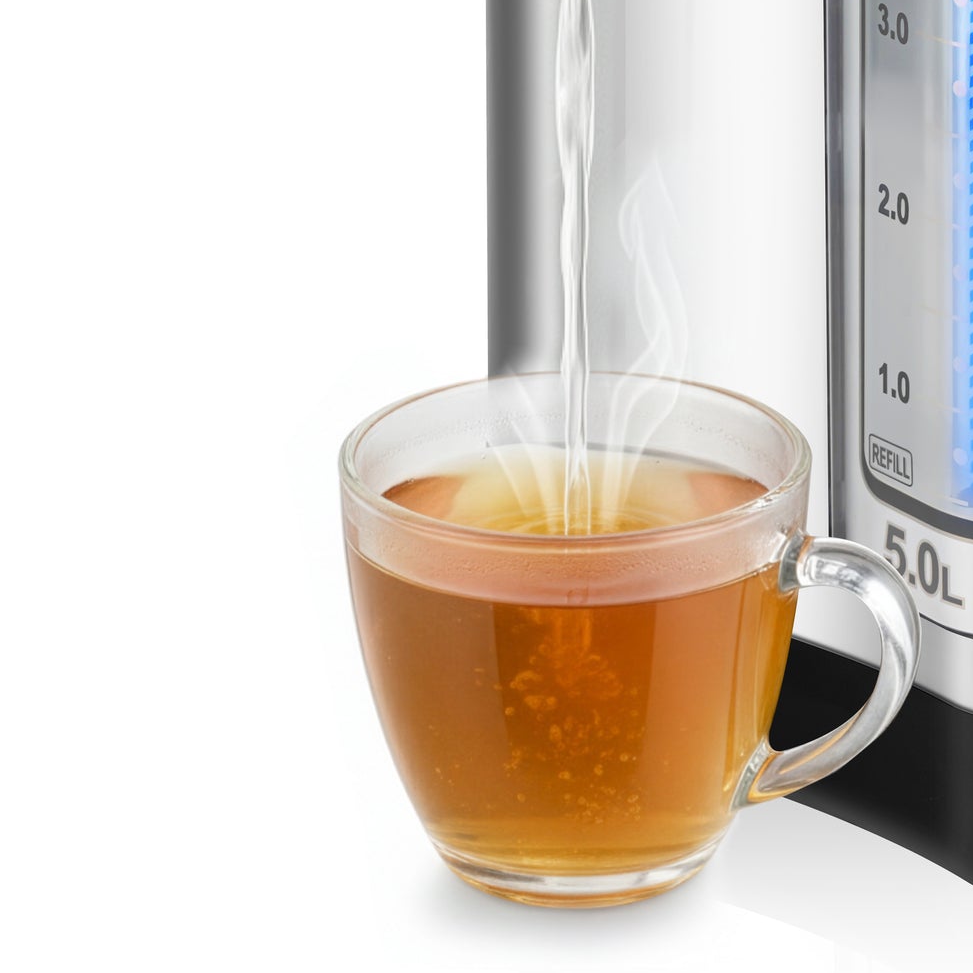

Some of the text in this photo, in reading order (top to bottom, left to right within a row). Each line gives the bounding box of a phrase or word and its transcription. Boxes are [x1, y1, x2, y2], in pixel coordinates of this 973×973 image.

[877, 3, 909, 45] 3.0
[878, 183, 910, 226] 2.0
[878, 362, 911, 405] 1.0
[872, 442, 911, 480] REFILL
[884, 522, 964, 608] 5.0L
